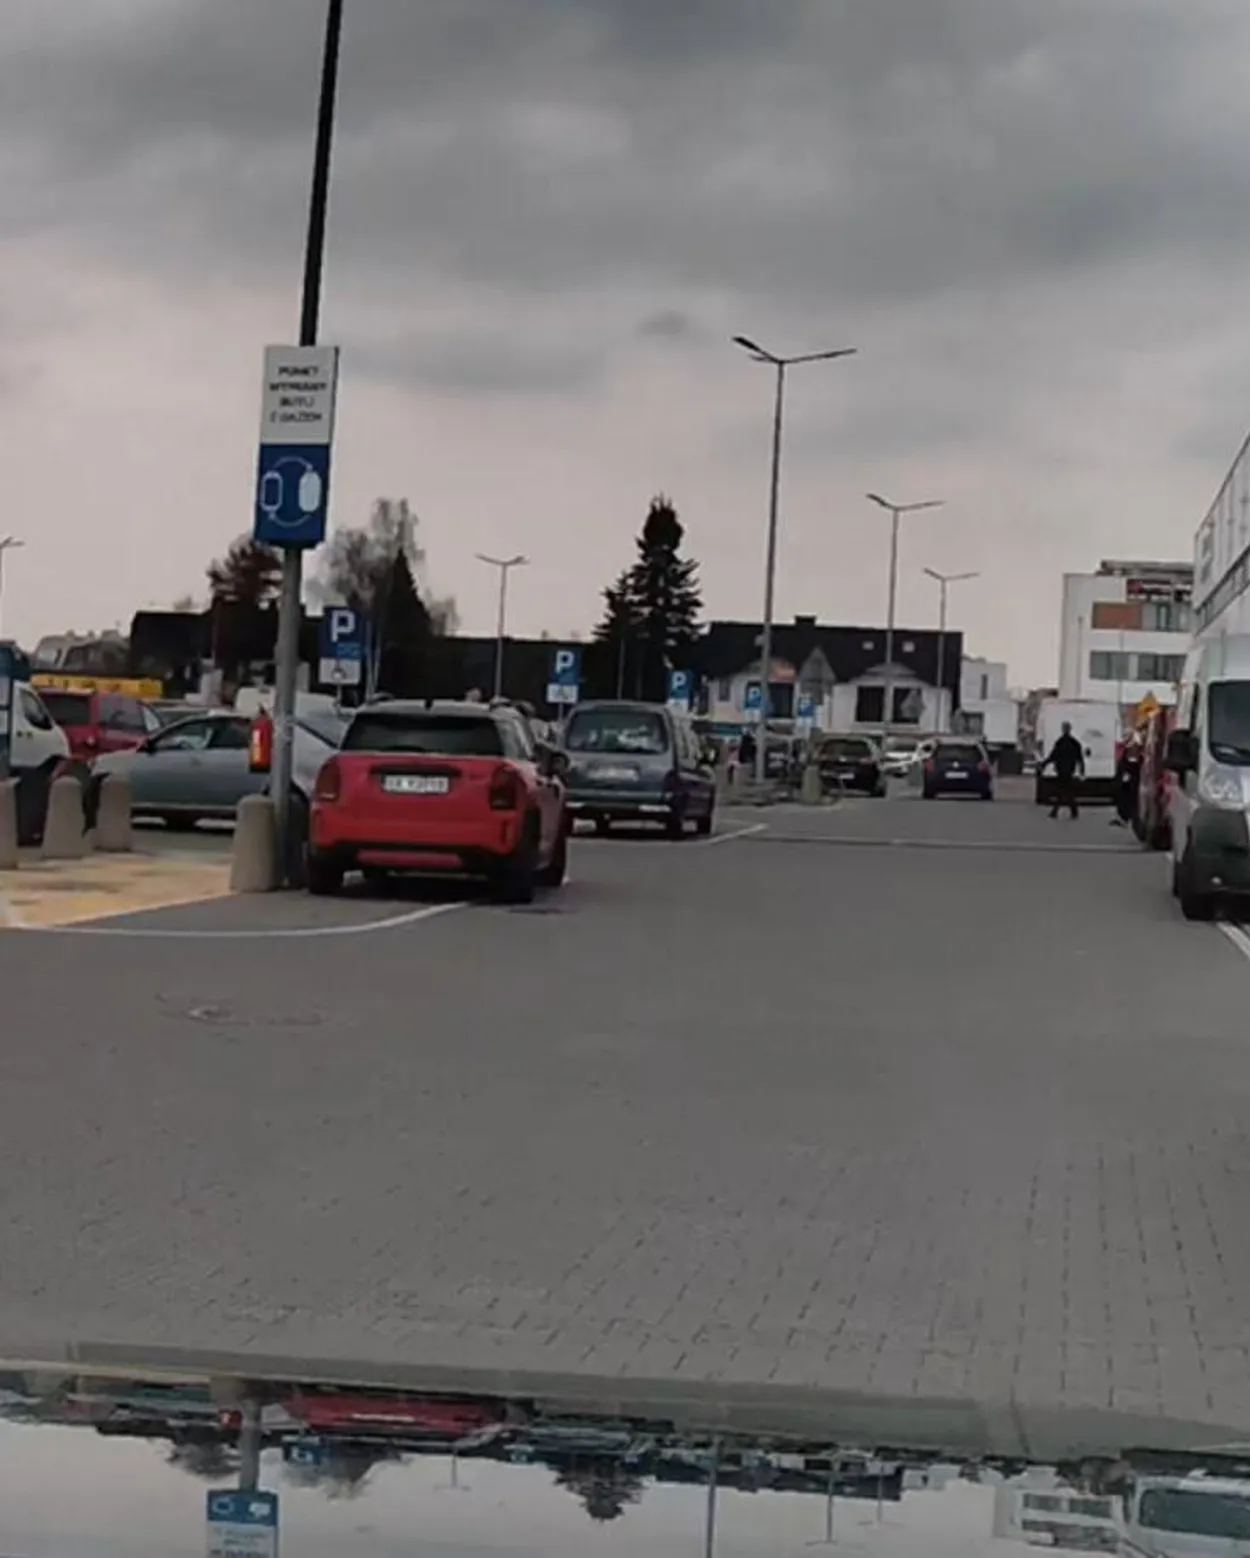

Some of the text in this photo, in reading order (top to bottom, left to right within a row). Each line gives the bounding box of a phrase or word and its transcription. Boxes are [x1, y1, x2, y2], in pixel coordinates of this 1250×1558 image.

[331, 609, 356, 642] P
[555, 650, 575, 674] P
[671, 670, 687, 691] P
